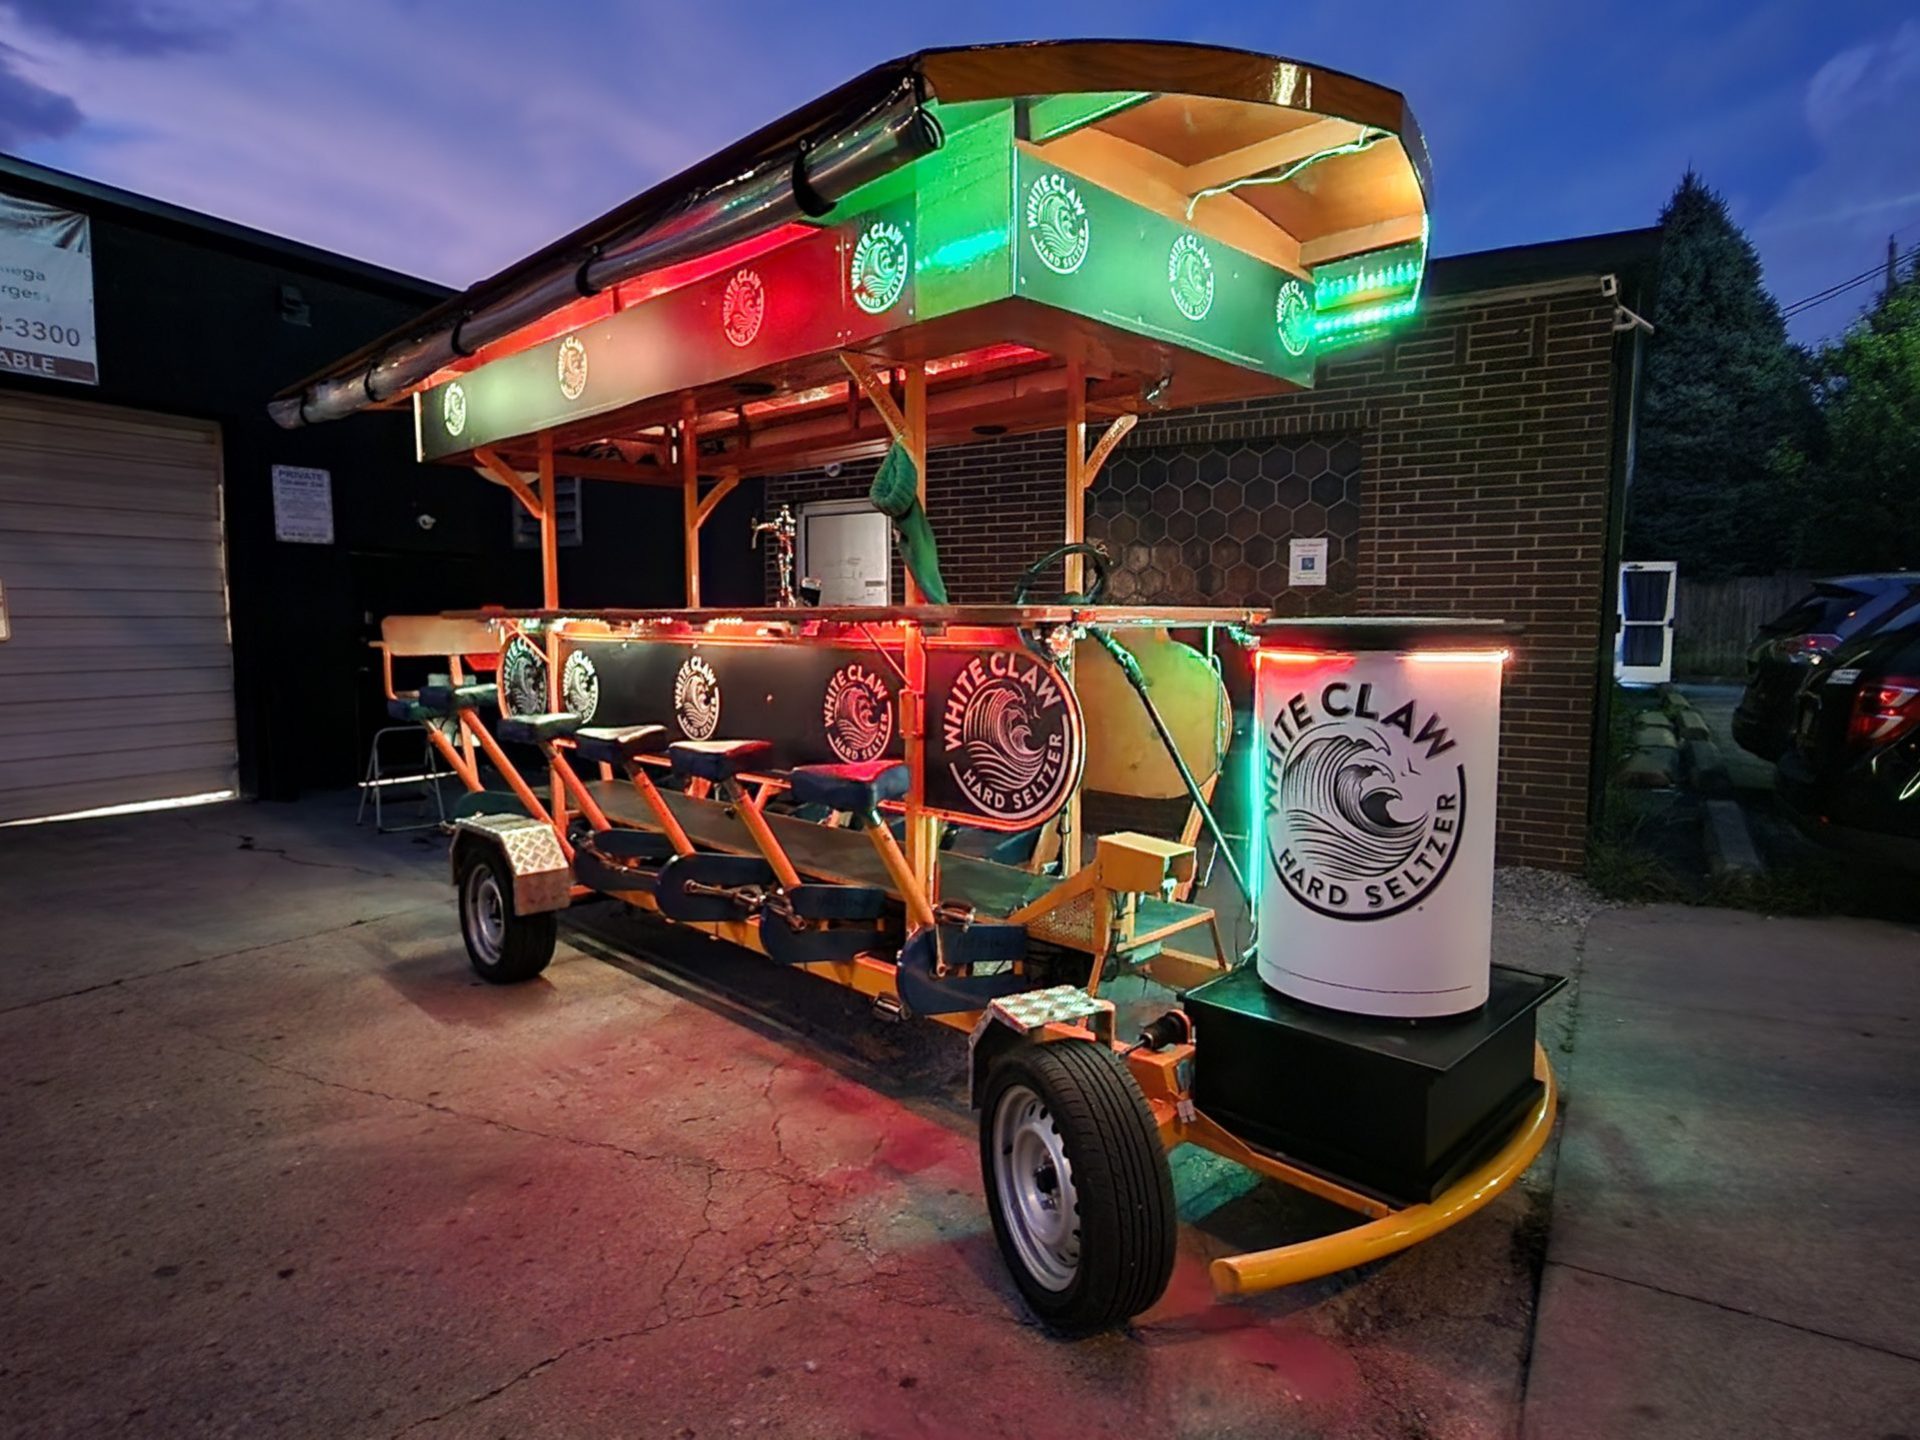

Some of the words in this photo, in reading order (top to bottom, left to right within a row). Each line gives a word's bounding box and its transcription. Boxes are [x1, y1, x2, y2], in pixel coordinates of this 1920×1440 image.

[1026, 174, 1051, 229] WHITE
[1050, 174, 1086, 216] CLAW
[851, 233, 872, 290] WHITE
[870, 222, 904, 246] CLAW
[1038, 240, 1061, 267] HARD
[1167, 235, 1187, 282] WHITE
[1186, 234, 1212, 269] CLAW
[0, 317, 80, 347] -3300
[675, 661, 691, 709] WHITE
[691, 656, 716, 687] CLAW
[824, 669, 847, 727] WHITE
[847, 664, 888, 700] CLAW
[943, 658, 987, 751] WHITE
[990, 652, 1062, 709] CLAW
[834, 737, 859, 760] HARD
[862, 713, 888, 760] SELTZER
[1321, 682, 1457, 760] CLAW
[962, 769, 1006, 809] HARD
[1012, 733, 1062, 810] SELTZER
[1278, 848, 1349, 906] HARD
[1365, 793, 1457, 909] SELTZER
